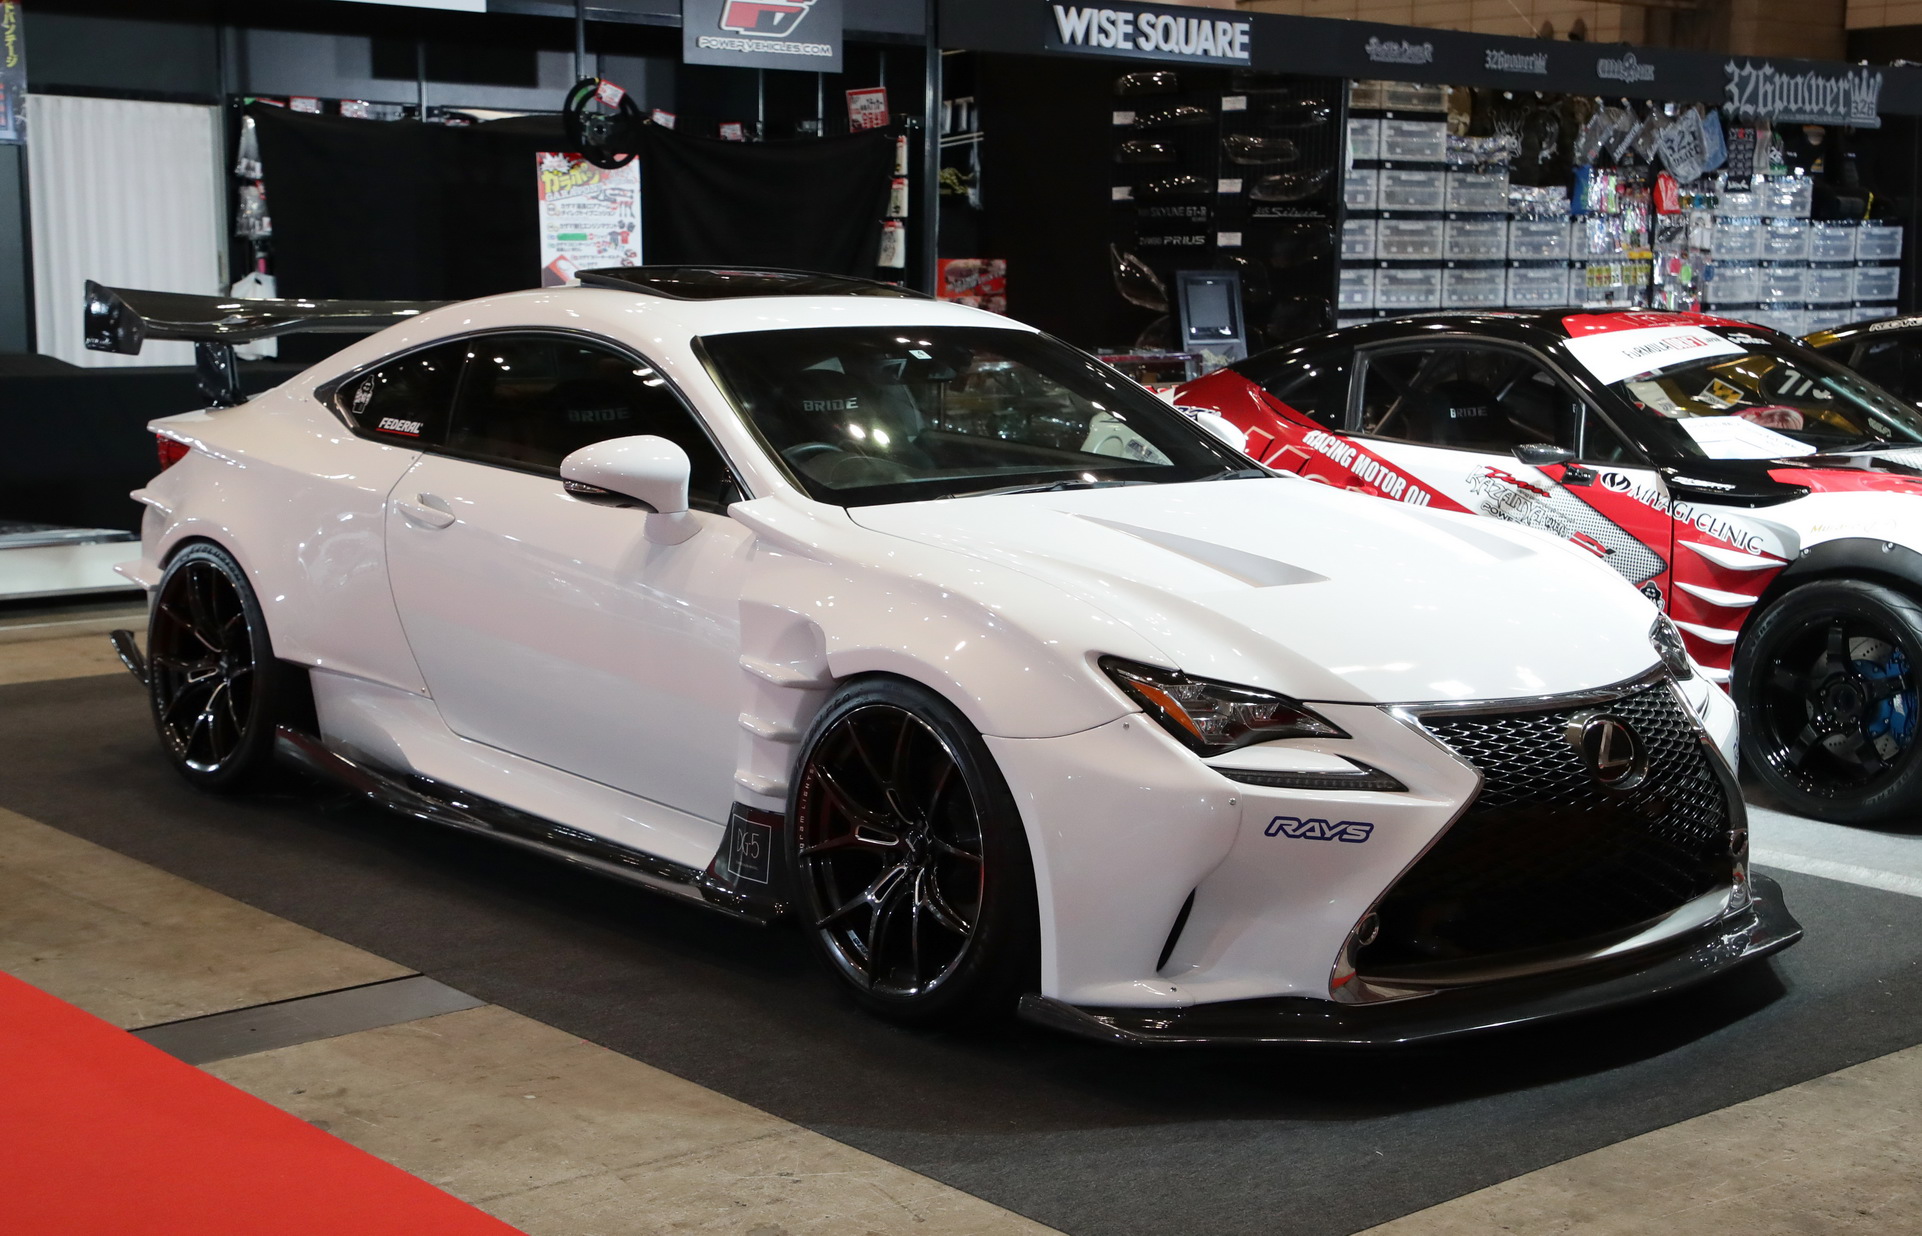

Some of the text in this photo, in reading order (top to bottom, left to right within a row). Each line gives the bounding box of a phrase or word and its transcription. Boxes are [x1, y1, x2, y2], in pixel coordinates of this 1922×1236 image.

[1053, 5, 1249, 59] WISE SQUARE
[697, 36, 833, 57] POWERVEHICLES.COM
[1163, 235, 1206, 245] PRIUS
[568, 407, 633, 422] BRIDE
[803, 397, 859, 412] BRIDE
[1449, 405, 1488, 418] BRIDE
[378, 417, 421, 434] FEDERAL
[1302, 430, 1357, 468] RACING
[1351, 453, 1407, 500] MOTOR
[1481, 502, 1523, 525] POWE
[1628, 483, 1693, 525] MIYAGI
[1695, 512, 1764, 556] CLINIC
[1264, 815, 1374, 844] RAYS
